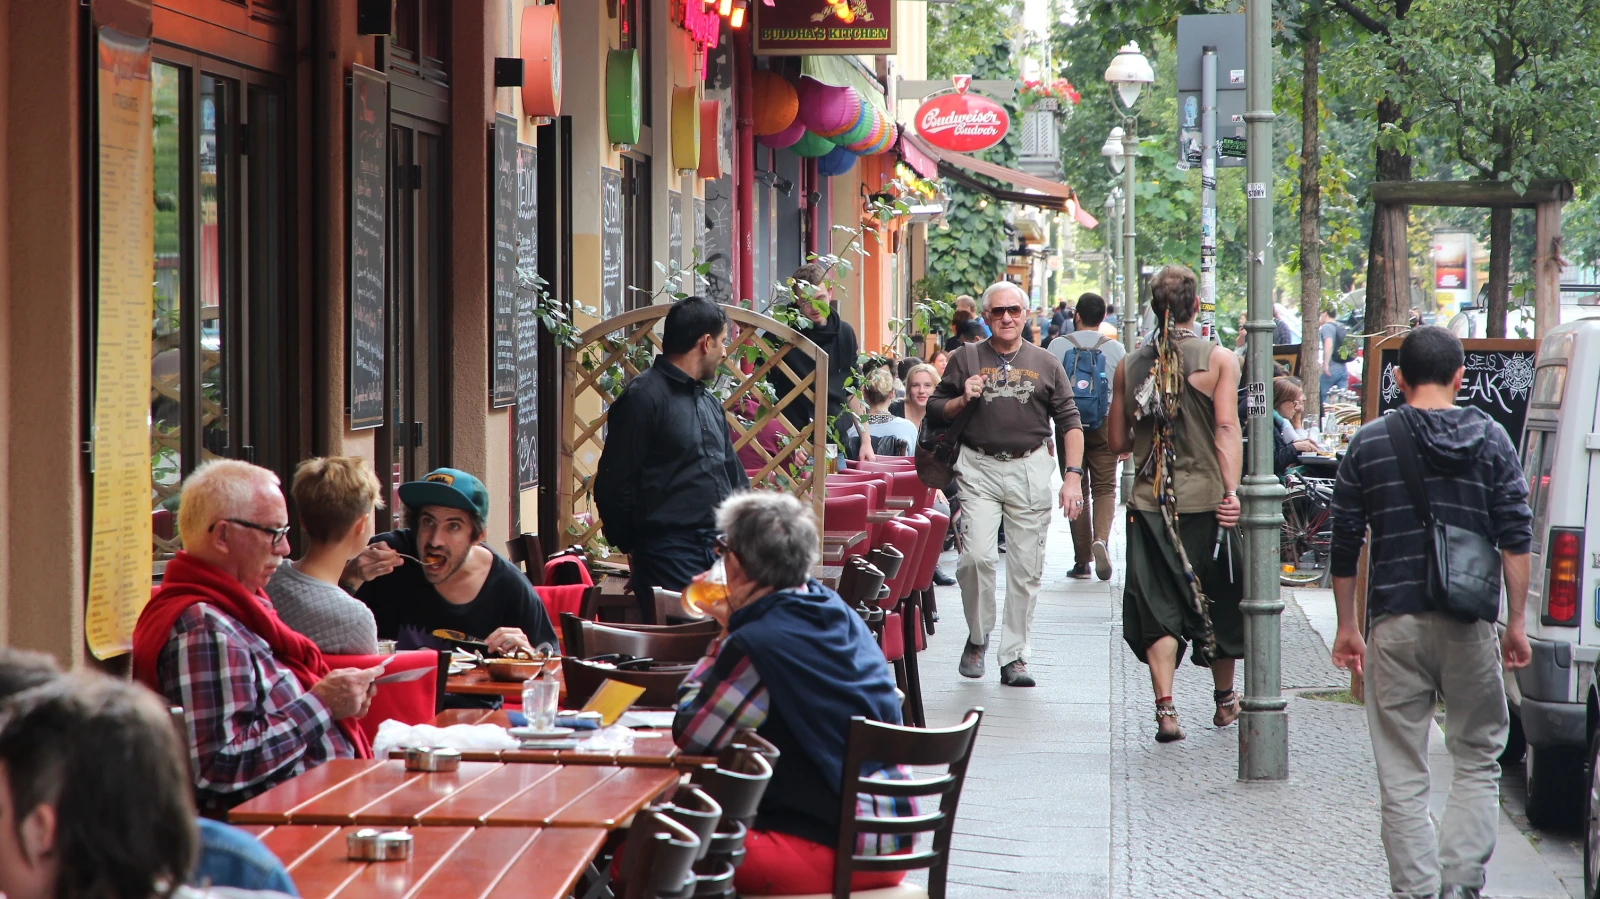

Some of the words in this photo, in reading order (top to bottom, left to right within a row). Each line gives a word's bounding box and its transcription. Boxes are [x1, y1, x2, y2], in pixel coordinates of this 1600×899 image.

[762, 26, 826, 41] BUDDHA'S
[828, 27, 889, 41] KITCHEN
[921, 107, 1001, 130] Budweiser
[953, 123, 998, 136] Budvar
[1456, 371, 1513, 414] EAK
